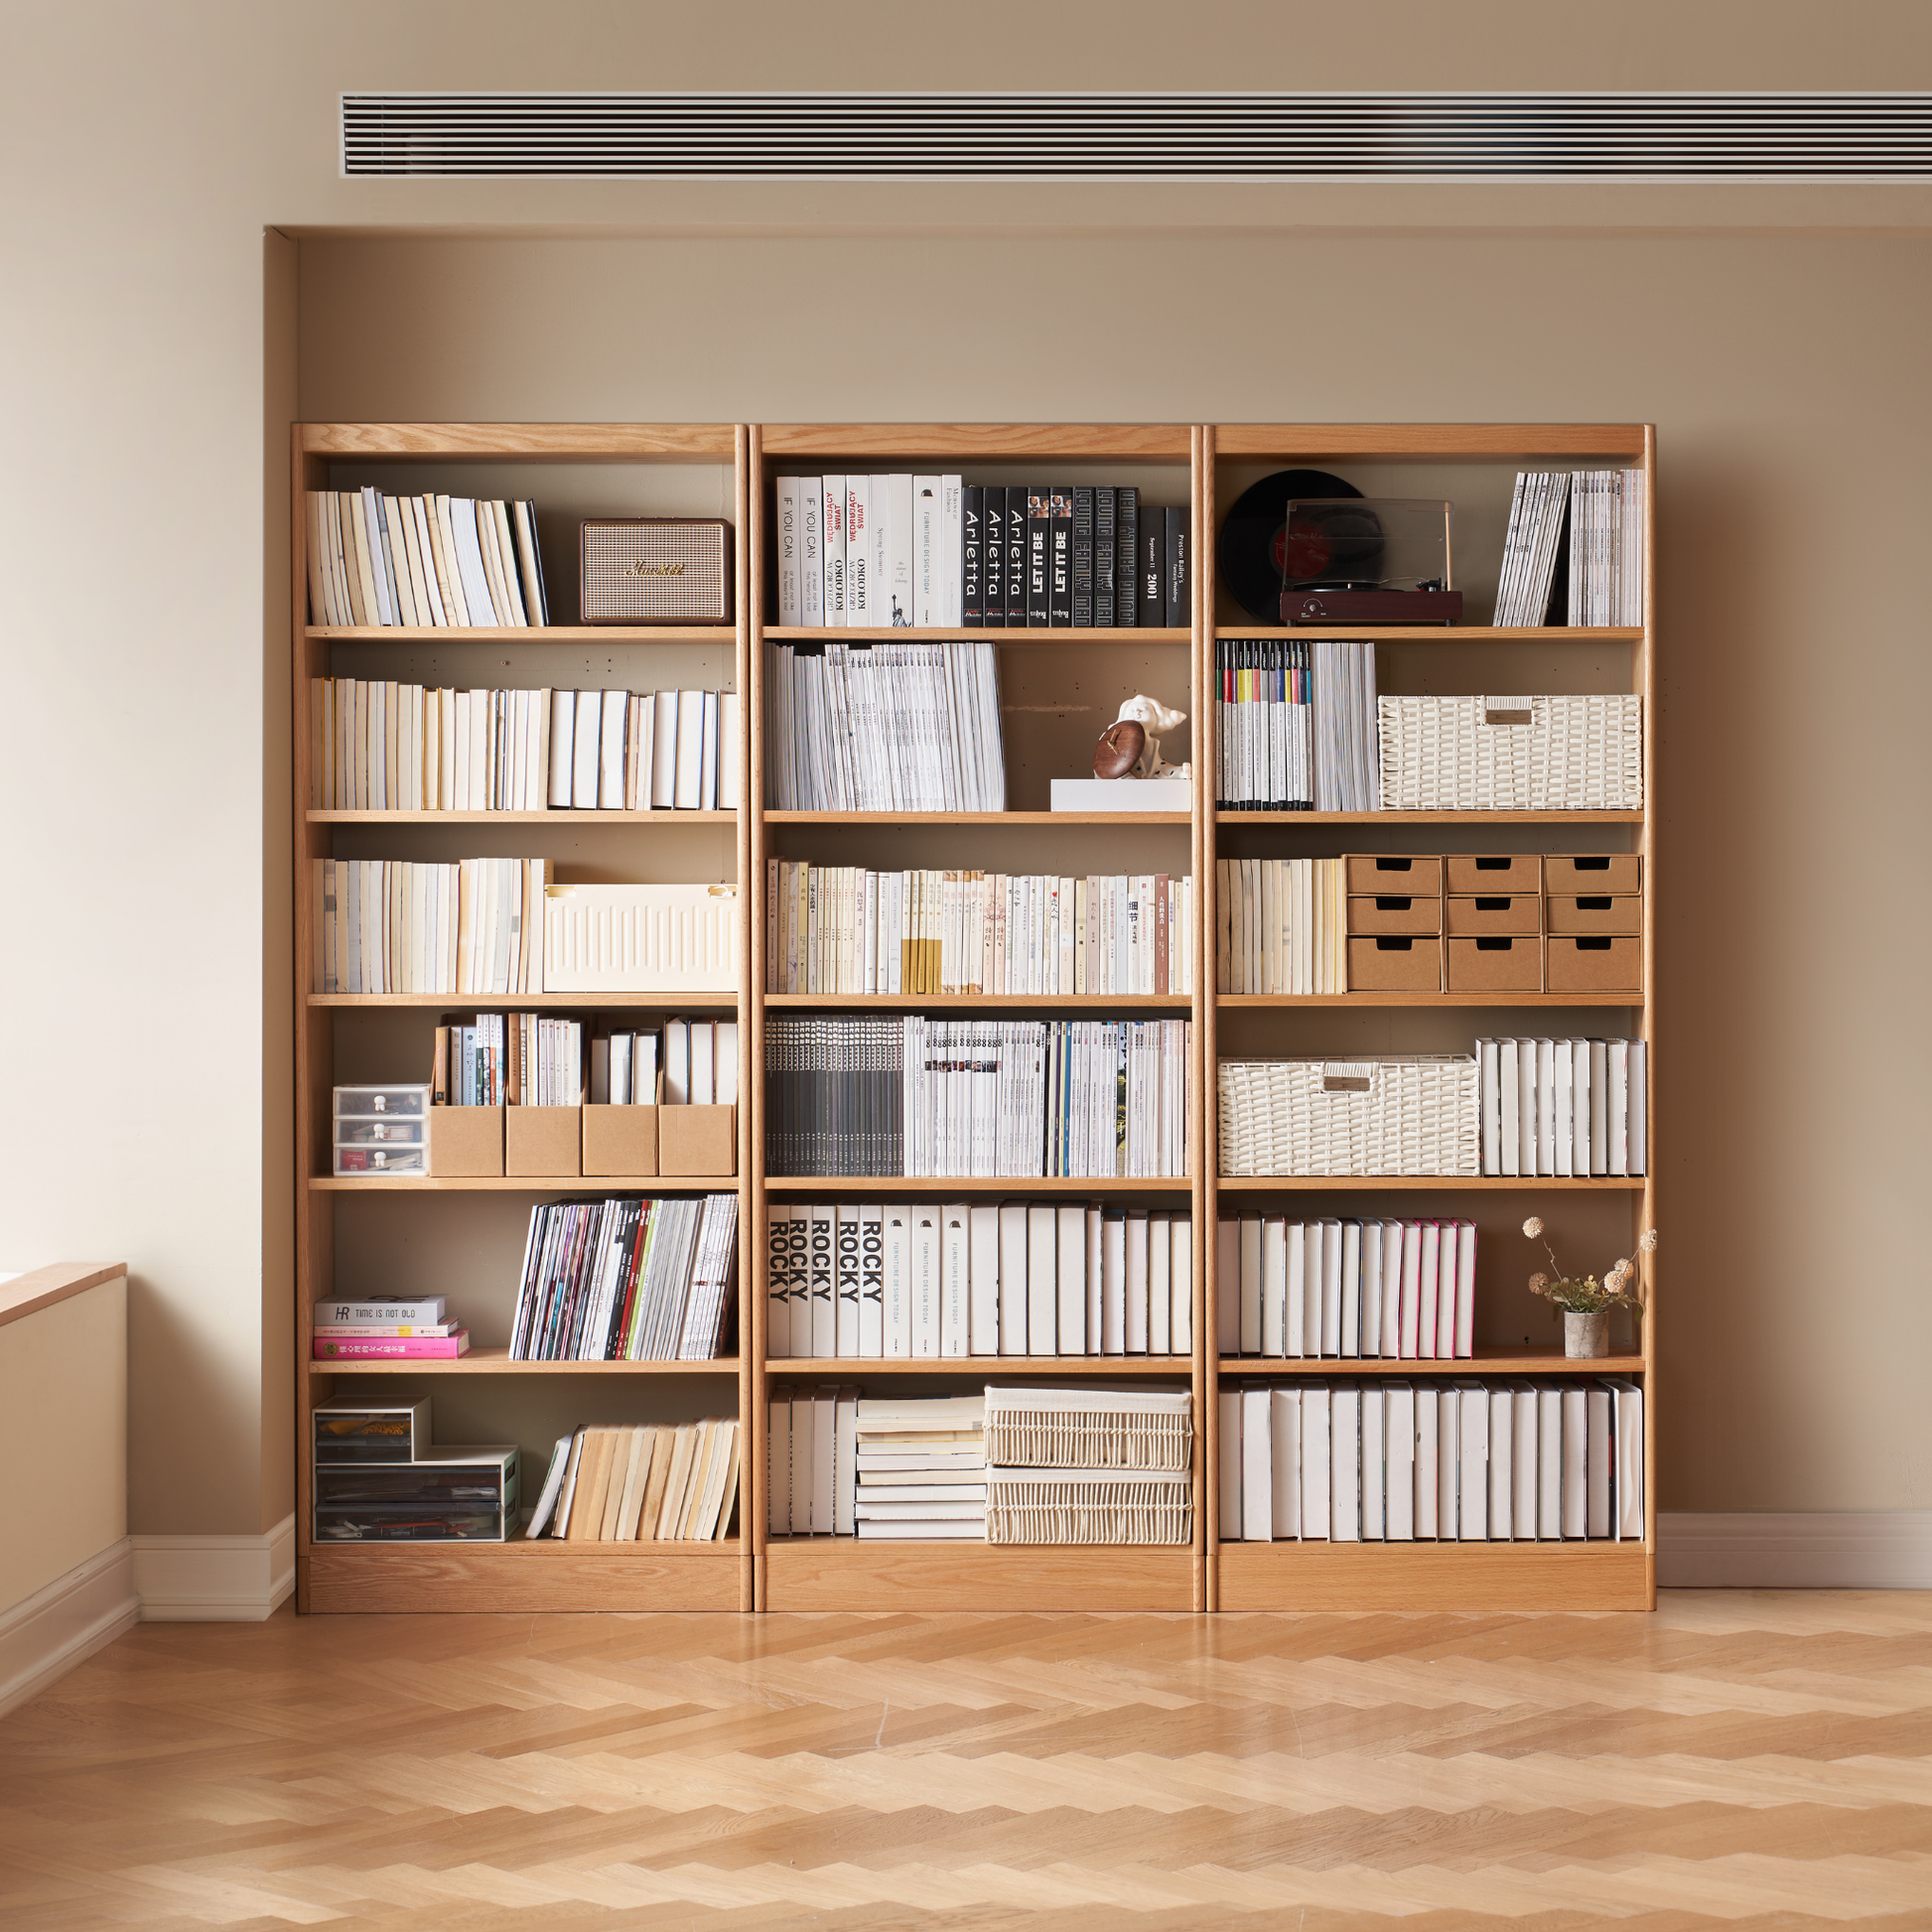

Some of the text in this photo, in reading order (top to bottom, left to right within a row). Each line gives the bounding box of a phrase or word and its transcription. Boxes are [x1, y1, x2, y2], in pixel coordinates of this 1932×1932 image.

[783, 497, 793, 559] IF YOU CAN
[807, 497, 816, 559] IF YOU CAN
[966, 510, 979, 596] Arletta
[989, 509, 1002, 596] Arletta
[1011, 509, 1024, 596] Arletta
[1033, 532, 1043, 593] LET IT BE
[1055, 531, 1066, 593] LET IT BE
[1075, 489, 1091, 626] LOVING FAMILY MAN
[1097, 489, 1113, 626] LOVING FAMILY MAN
[1147, 574, 1158, 600] 2001
[1176, 559, 1185, 584] Bailey's
[1129, 900, 1139, 923] 细节
[769, 1221, 789, 1304] ROCKY
[789, 1219, 808, 1302] ROCKY
[812, 1219, 831, 1302] ROCKY
[839, 1221, 859, 1304] ROCKY
[863, 1221, 882, 1304] ROCKY
[355, 1309, 373, 1317] TIME
[375, 1309, 382, 1317] IS
[385, 1309, 398, 1317] NOT
[401, 1309, 416, 1318] OLD
